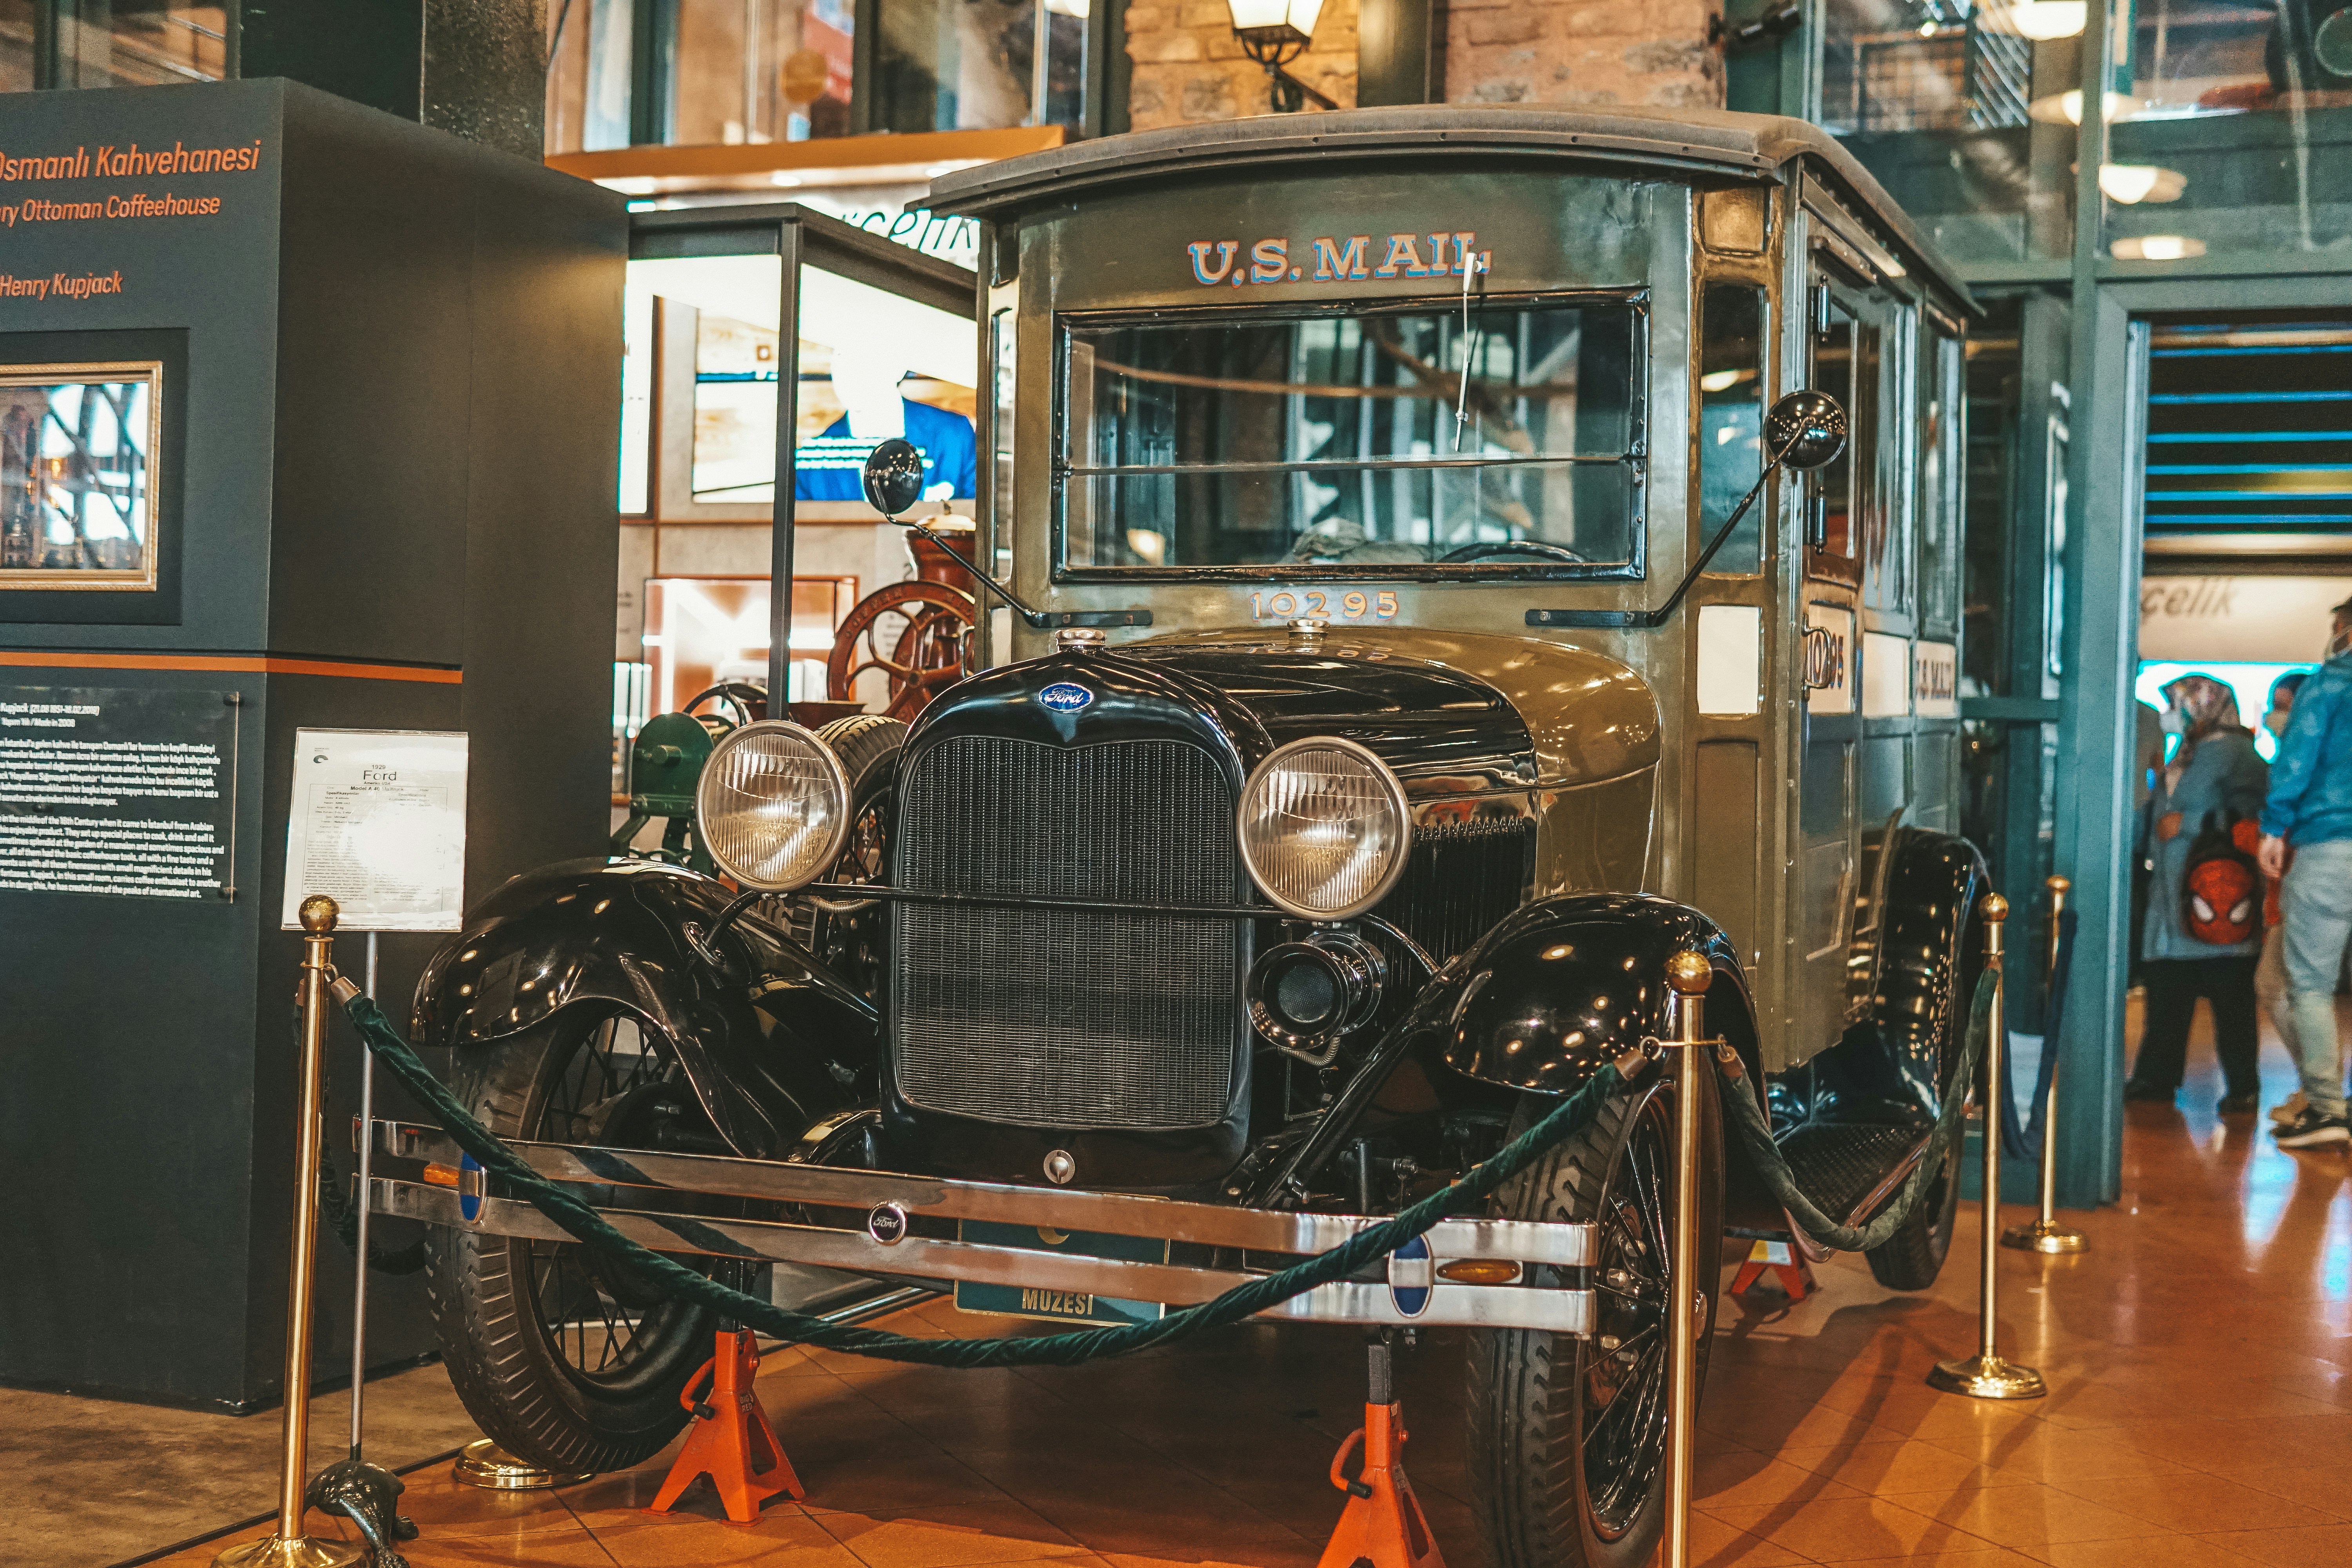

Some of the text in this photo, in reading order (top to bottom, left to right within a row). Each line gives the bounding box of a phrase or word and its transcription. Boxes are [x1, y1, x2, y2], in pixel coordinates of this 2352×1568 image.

[95, 140, 262, 177] Kahvehanesi
[22, 198, 103, 221] Ottoman
[106, 193, 221, 218] Coffeehouse
[1187, 231, 1492, 289] U.S. MAIL
[0, 270, 123, 301] Henry Kupjack
[1250, 591, 1399, 622] 10295
[1045, 687, 1084, 704] Ford
[363, 770, 397, 780] Ford
[872, 1215, 899, 1229] Ford
